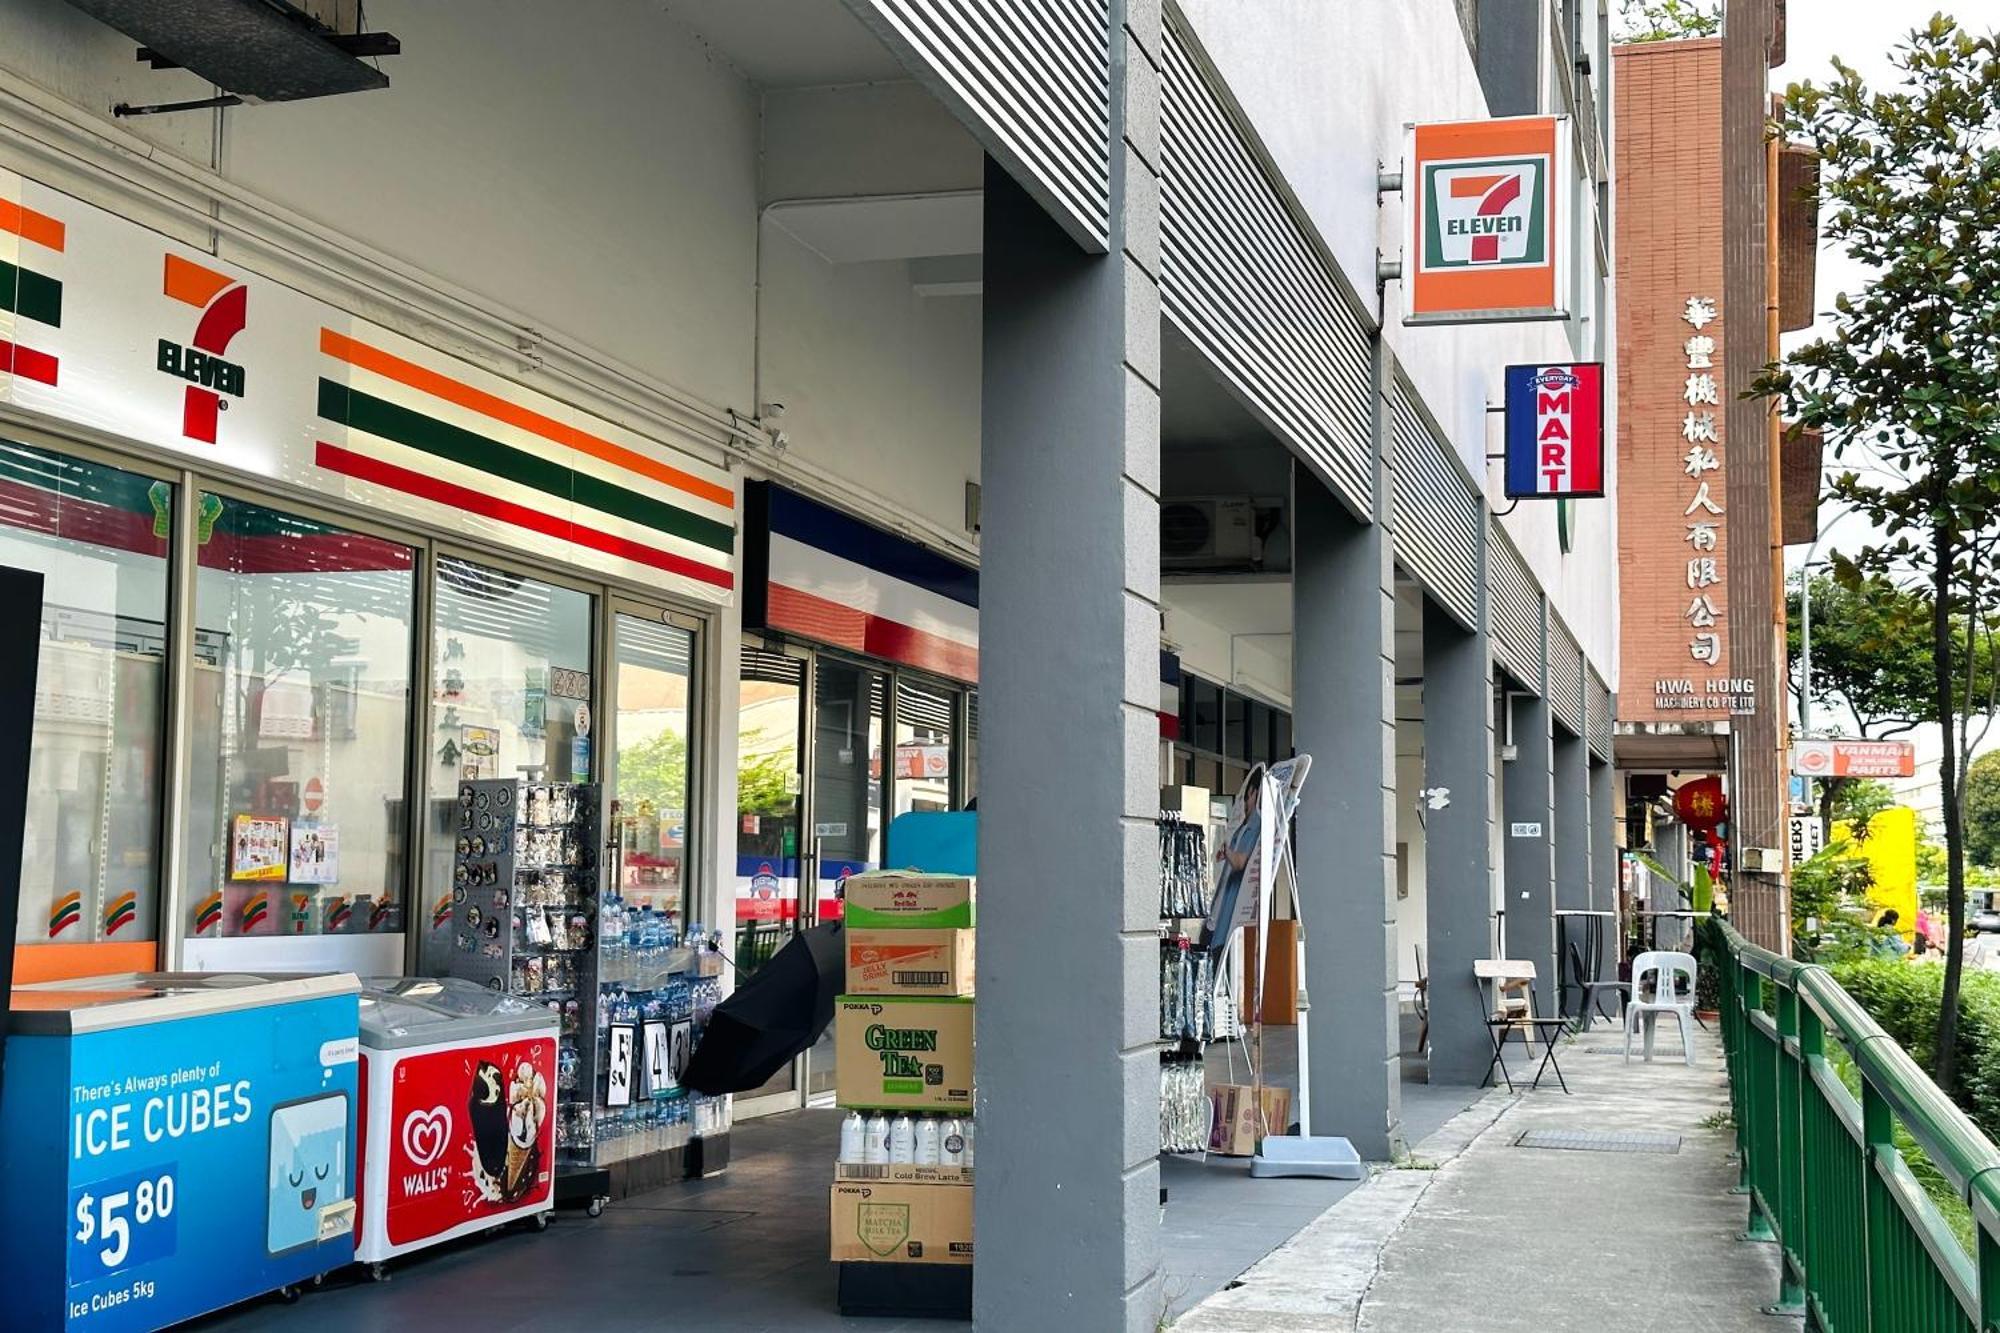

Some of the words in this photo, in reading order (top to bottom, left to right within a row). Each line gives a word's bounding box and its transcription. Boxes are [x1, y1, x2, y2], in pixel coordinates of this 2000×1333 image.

[1536, 375, 1574, 384] EVERYDAY
[1539, 391, 1569, 492] MART
[1655, 680, 1694, 694] HWA
[1706, 679, 1754, 693] HONG
[1706, 697, 1719, 709] CO
[1722, 696, 1738, 708] PTE
[1740, 696, 1755, 708] LTD
[865, 1023, 938, 1051] GREEN
[880, 1051, 923, 1077] TEA
[73, 1081, 121, 1104] There's
[125, 1071, 168, 1094] Always
[171, 1066, 206, 1086] plenty
[209, 1061, 221, 1078] of
[74, 1103, 132, 1160] ICE
[143, 1080, 252, 1143] CUBES
[403, 1169, 448, 1197] WALL'S
[894, 1172, 913, 1180] Cold
[914, 1173, 936, 1181] Brew
[838, 1187, 861, 1195] POKKA
[69, 1301, 89, 1319] Ice
[92, 1289, 130, 1311] Cubes
[133, 1280, 155, 1300] 5kg
